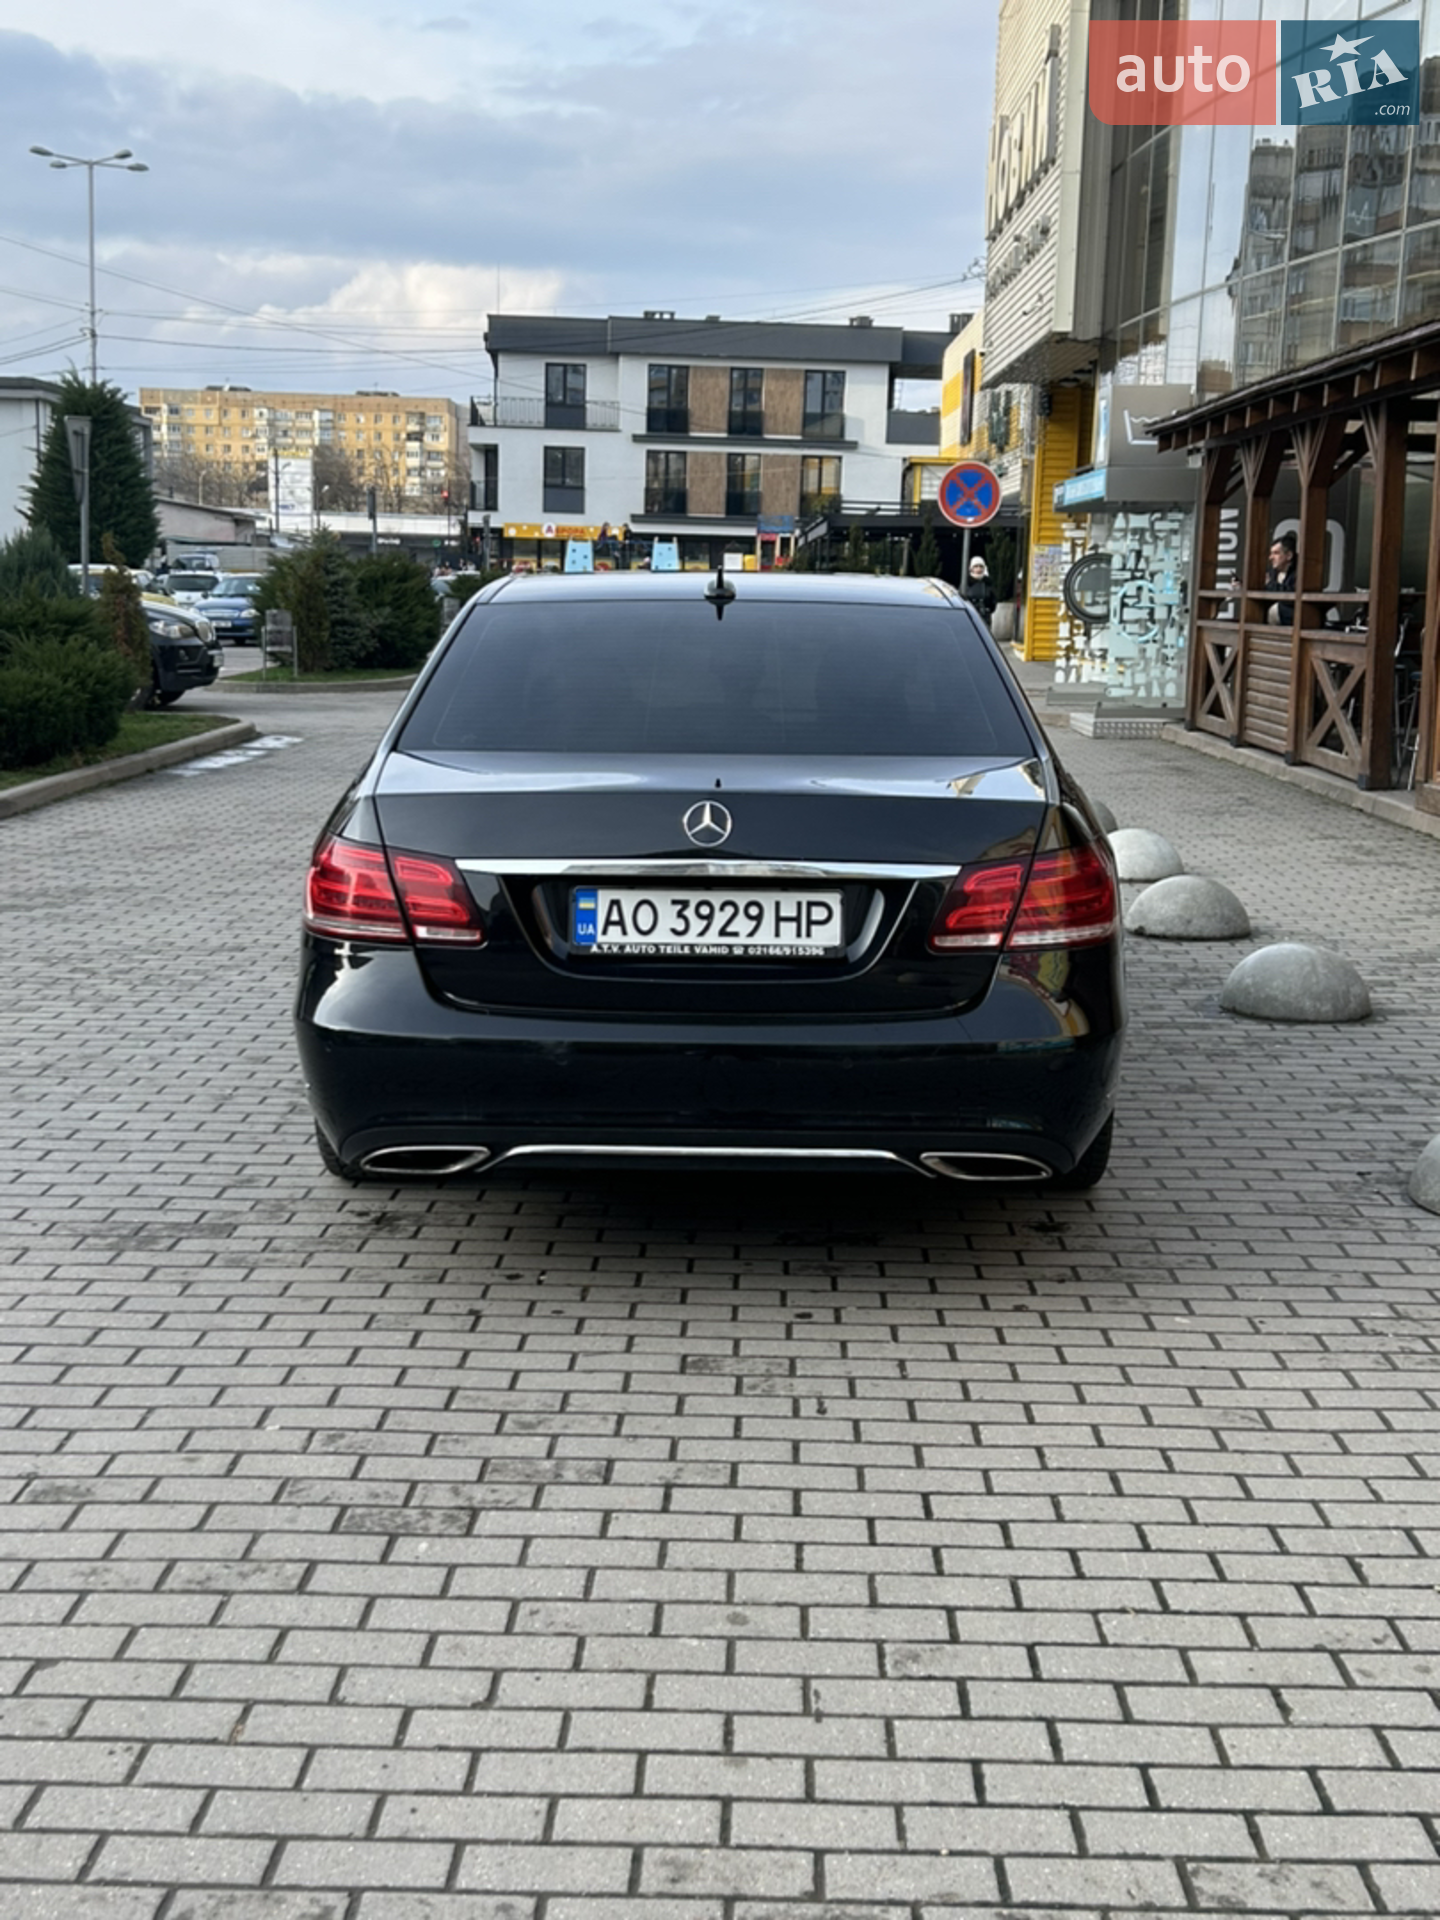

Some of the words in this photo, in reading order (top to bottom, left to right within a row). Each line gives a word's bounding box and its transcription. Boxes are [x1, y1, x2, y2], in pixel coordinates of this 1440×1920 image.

[601, 898, 659, 937] AO
[670, 898, 765, 938] 3929
[774, 900, 834, 939] HP
[578, 925, 596, 936] UA
[624, 944, 656, 954] AUTO
[659, 944, 691, 954] TEILE
